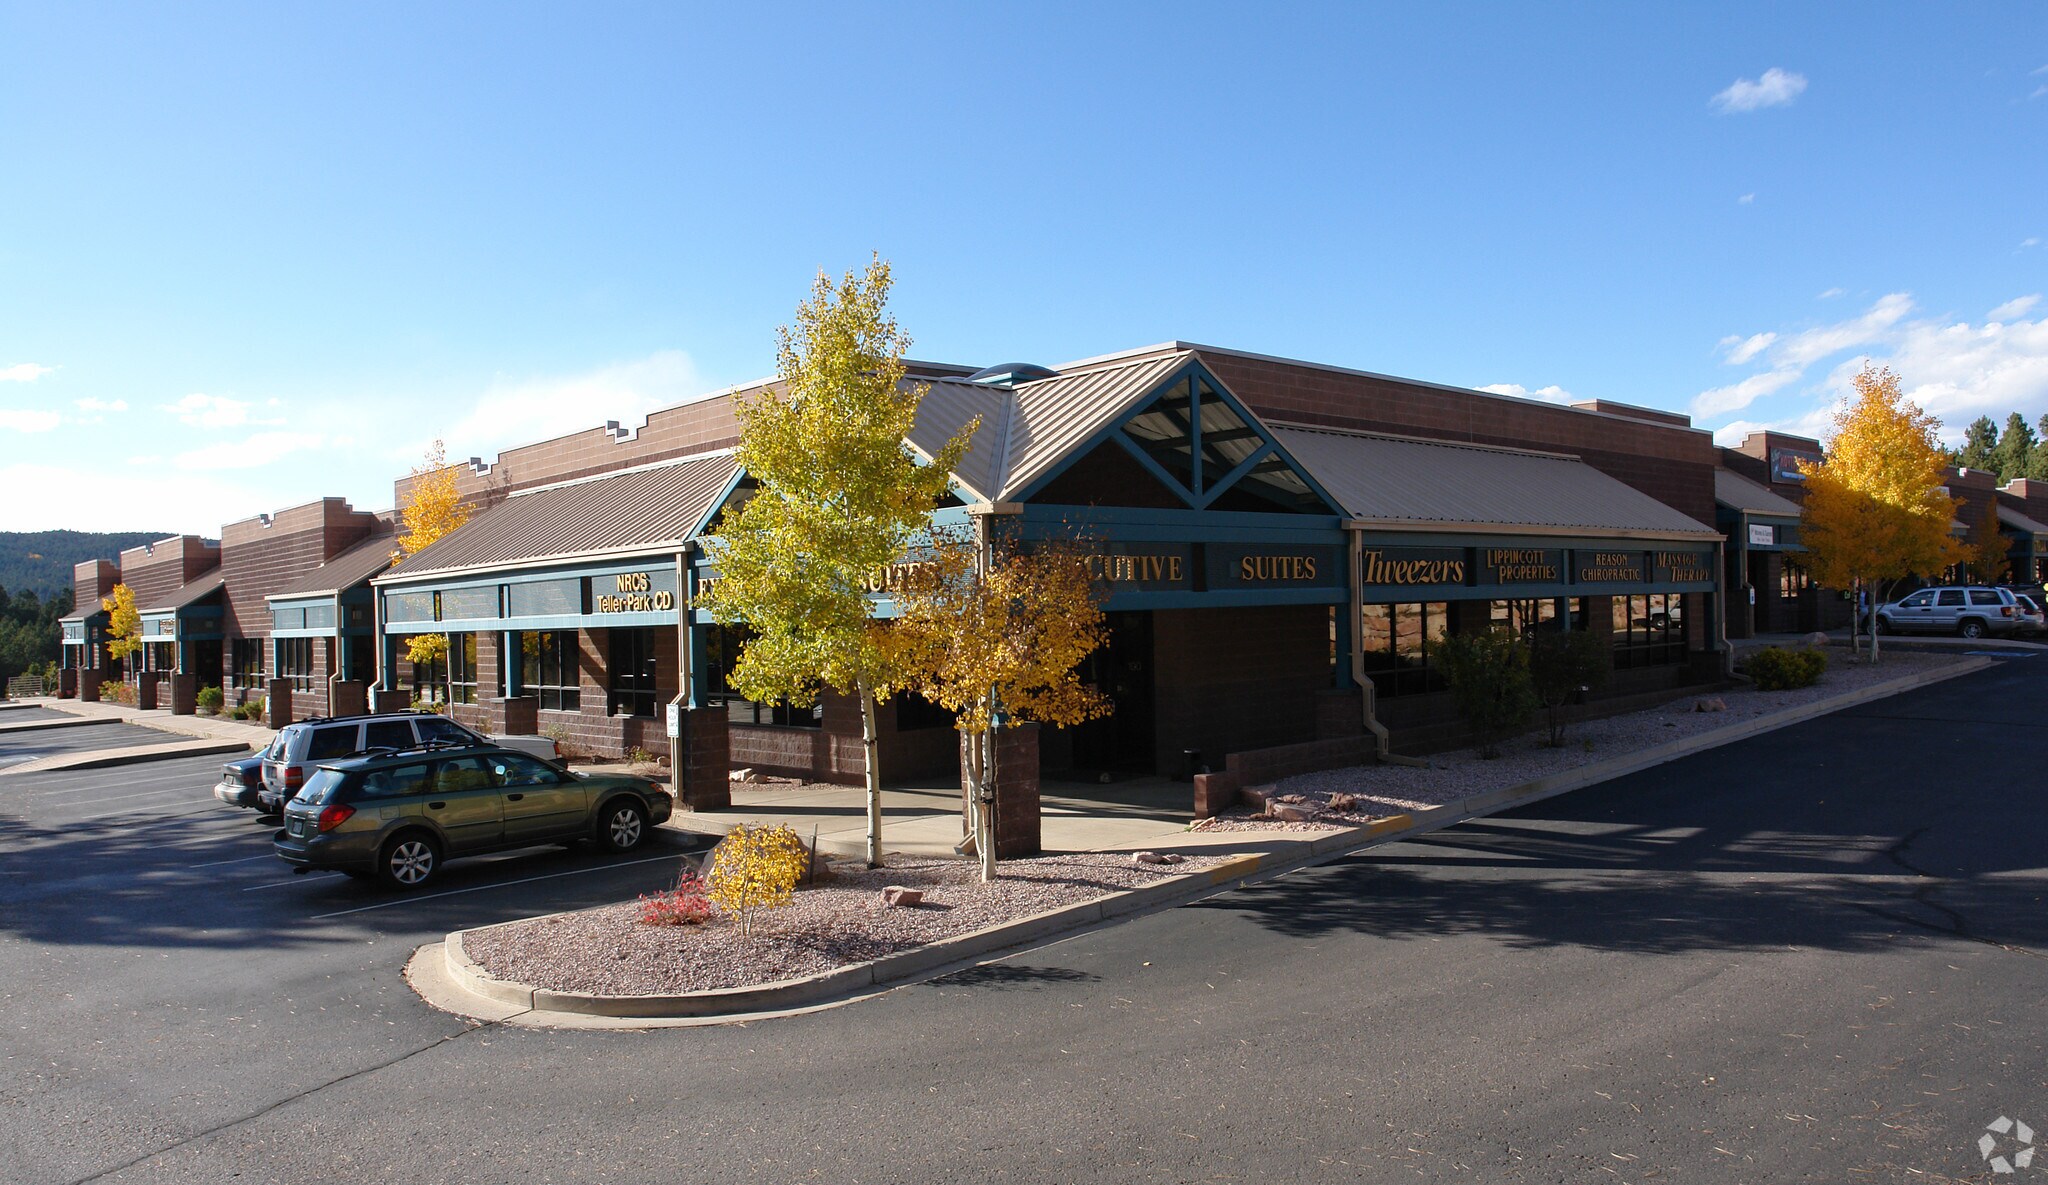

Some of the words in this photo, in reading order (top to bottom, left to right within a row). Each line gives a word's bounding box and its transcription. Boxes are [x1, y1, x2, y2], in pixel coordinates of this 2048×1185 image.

[1083, 554, 1184, 582] CUTIVE
[1241, 556, 1317, 581] SUITES
[1364, 549, 1464, 584] Tweezers
[1487, 549, 1545, 568] LIPPINCOTT
[1595, 553, 1628, 566] REASON
[1656, 551, 1697, 568] MASSAGE
[616, 572, 650, 593] NRCS
[1498, 564, 1557, 585] PROPERTIES
[1581, 568, 1641, 582] CHIROPRACTIC
[1670, 566, 1709, 582] THERAPY
[597, 594, 653, 613] Teller-Park
[654, 591, 673, 611] CD
